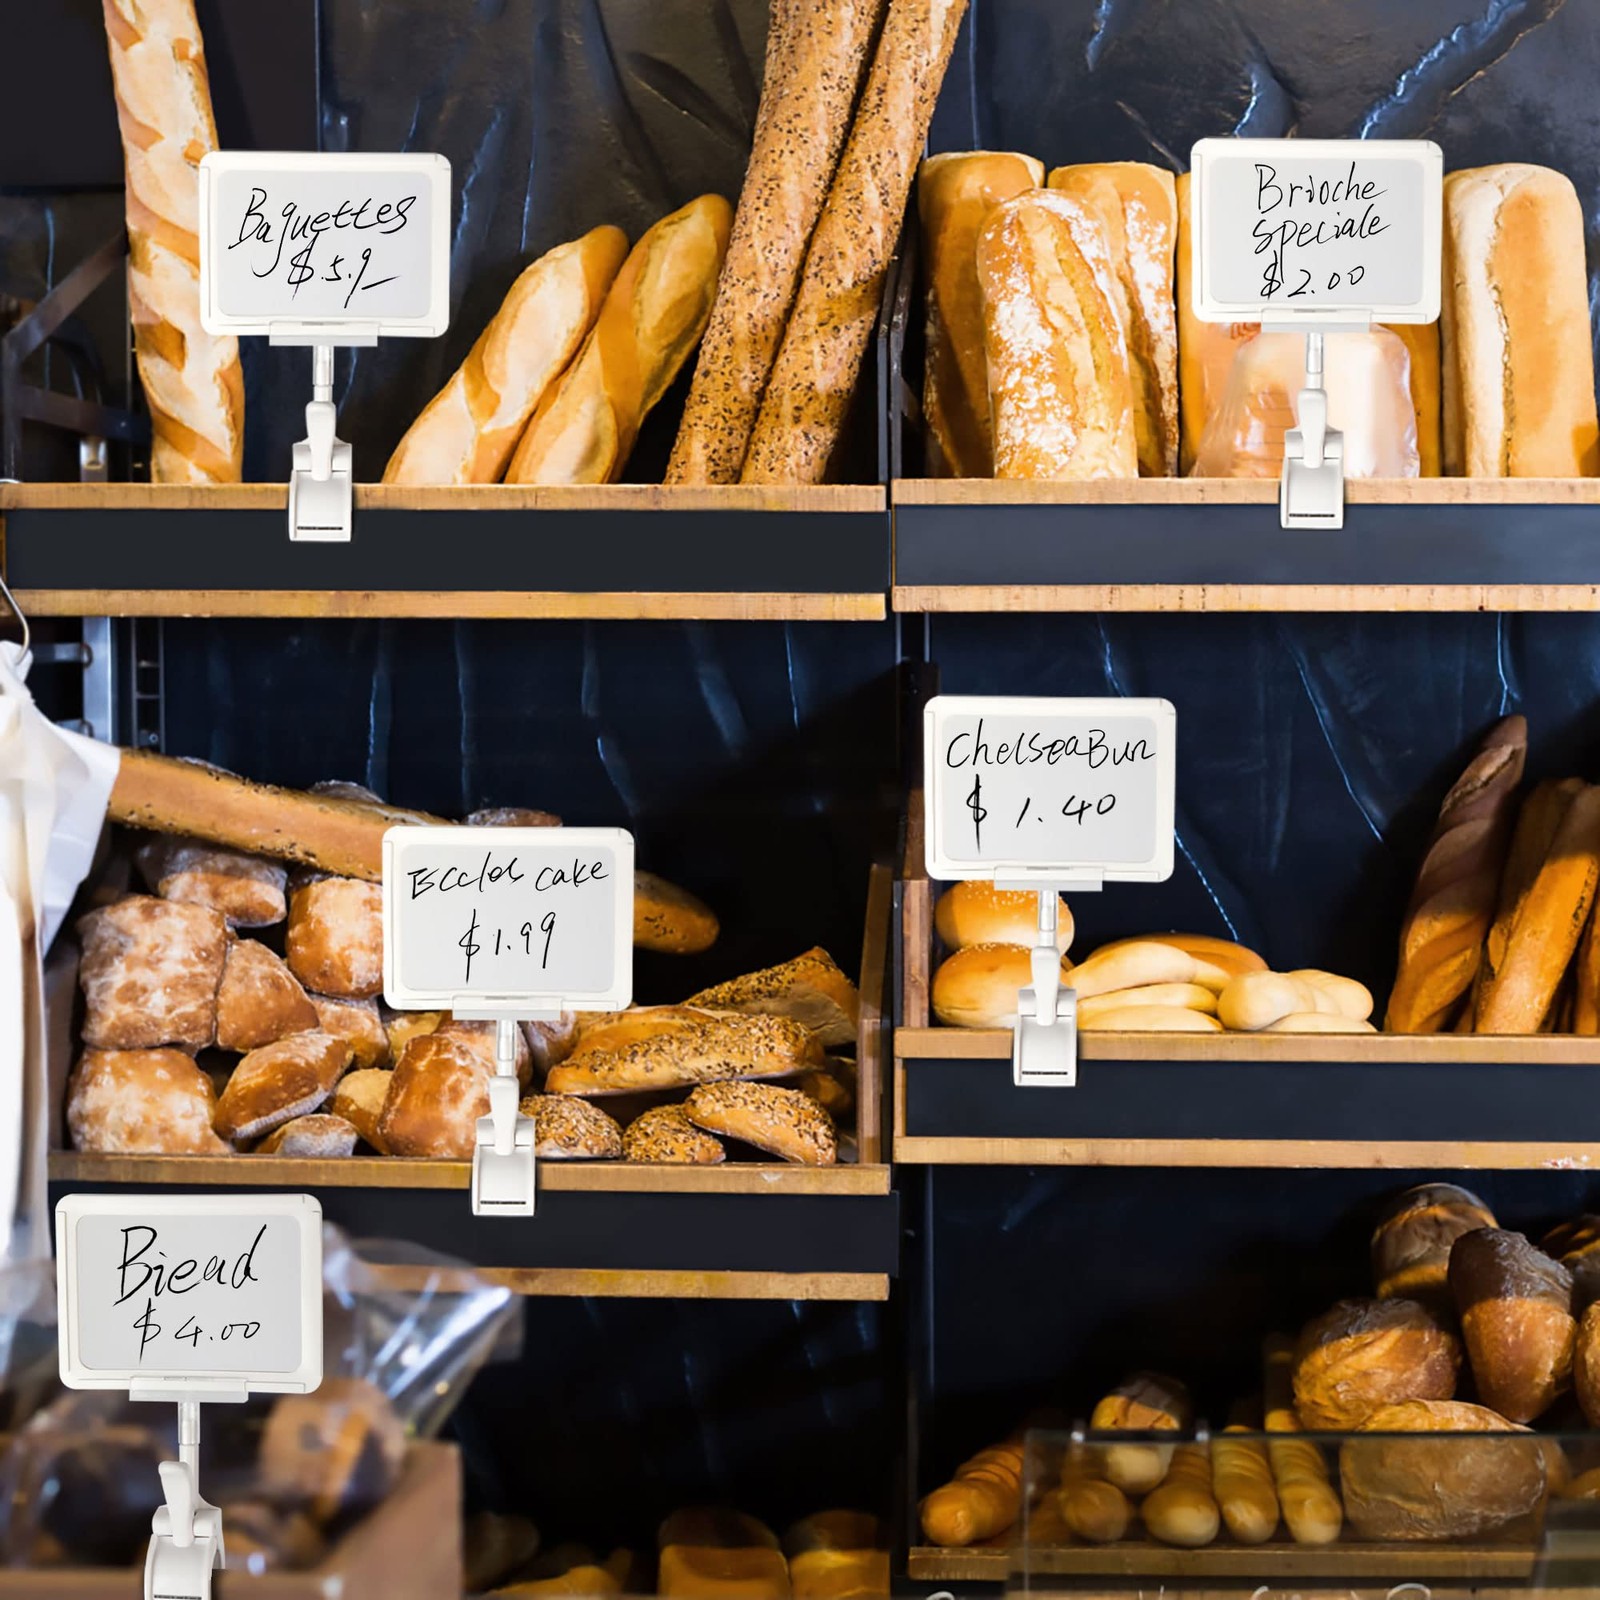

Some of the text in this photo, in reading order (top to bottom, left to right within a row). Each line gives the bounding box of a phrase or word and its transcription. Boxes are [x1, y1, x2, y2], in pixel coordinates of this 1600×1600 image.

[1254, 160, 1389, 215] Brioche
[226, 186, 417, 279] Baguettes
[1260, 249, 1366, 300] $2.00
[458, 907, 557, 984] $1.99
